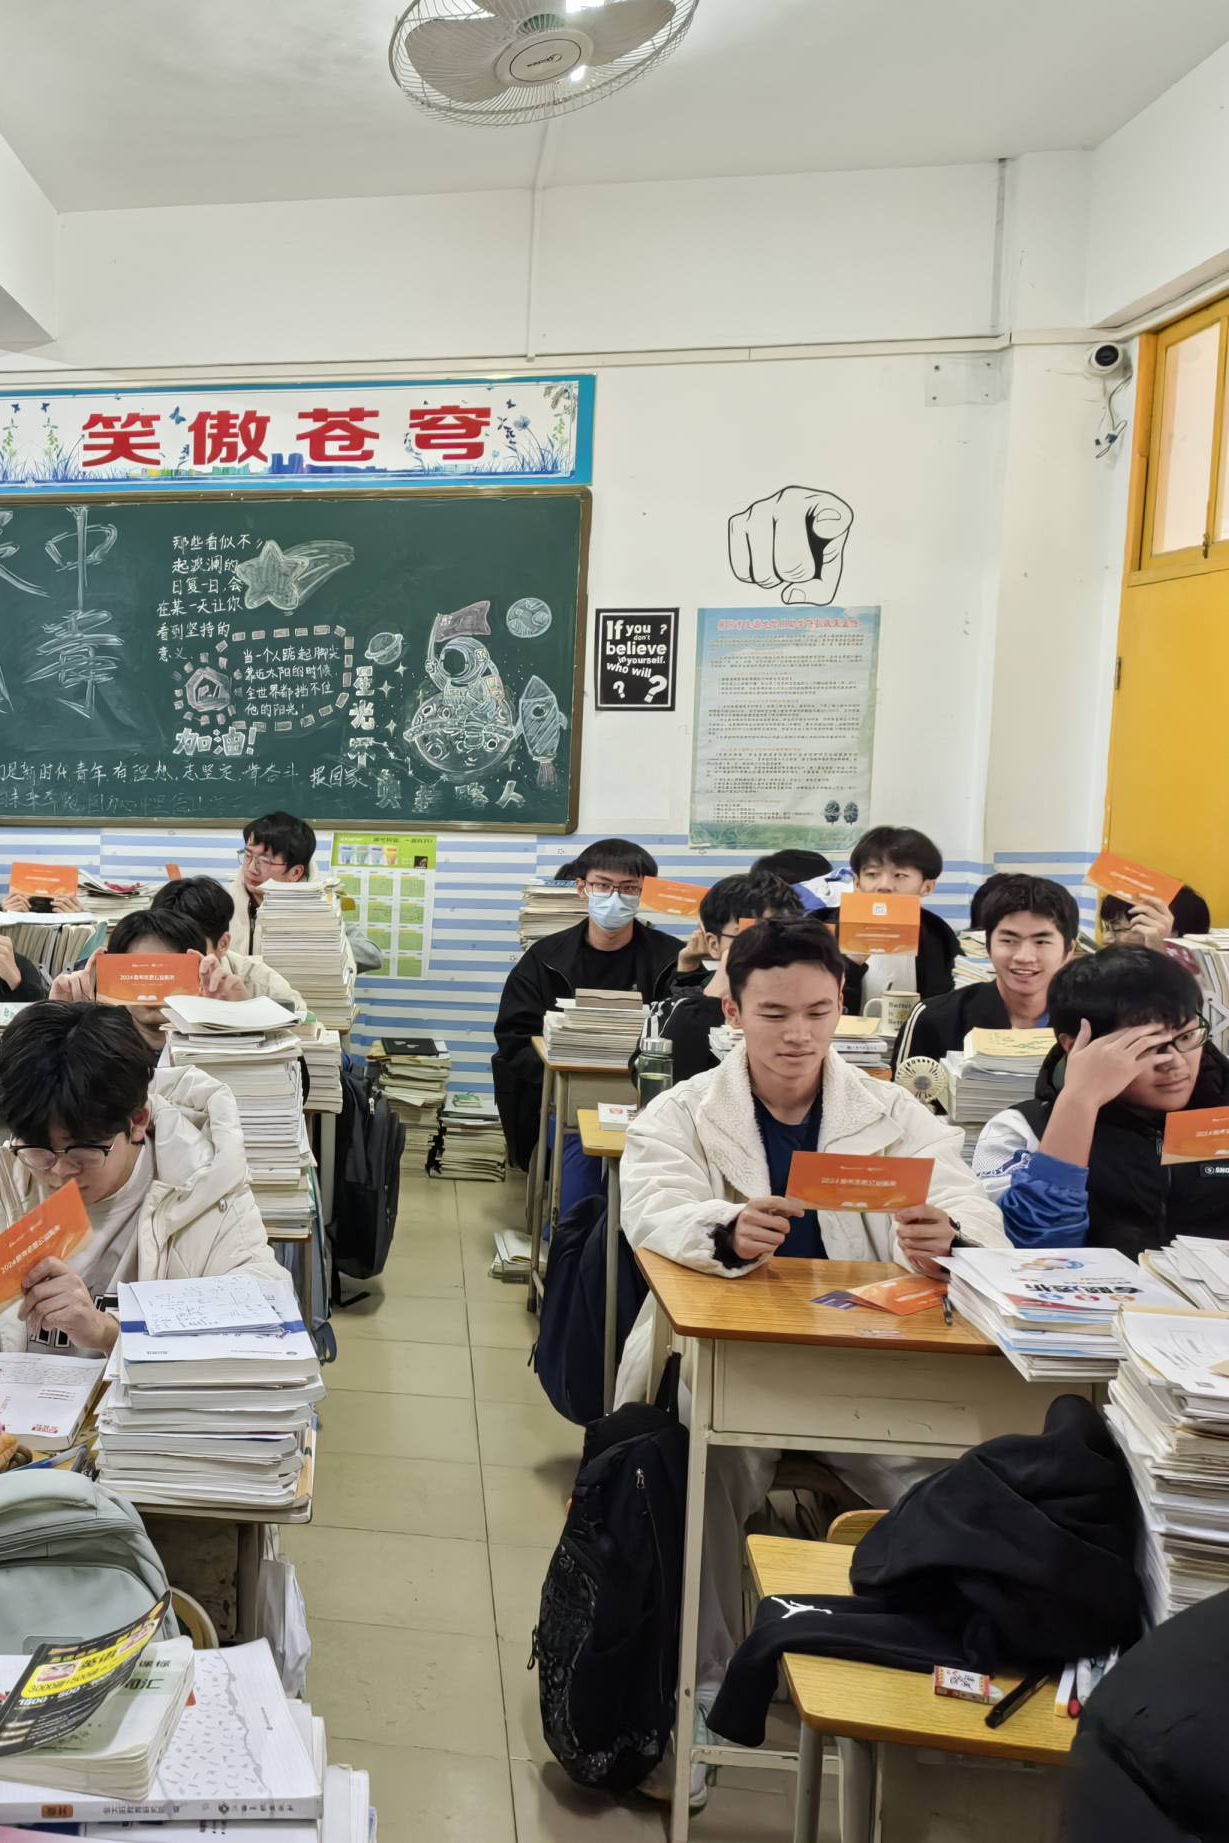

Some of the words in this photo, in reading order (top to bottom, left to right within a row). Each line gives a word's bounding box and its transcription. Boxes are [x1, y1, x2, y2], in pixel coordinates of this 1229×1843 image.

[82, 404, 492, 468] 笑傲苍穹
[172, 534, 251, 554] 那些看似不
[172, 556, 239, 575] 起波澜的
[156, 597, 244, 617] 在某一天让你
[156, 621, 231, 641] 看到坚持的
[606, 619, 624, 640] If
[625, 624, 651, 637] you
[660, 624, 668, 635] ?
[243, 646, 340, 665] 当一个人踮起脚尖
[606, 641, 667, 655] believe
[606, 662, 629, 674] who
[632, 667, 652, 678] will
[618, 655, 627, 664] in
[627, 655, 666, 666] yourself.
[245, 682, 335, 700] 全世界都挡不住
[613, 680, 626, 698] ?
[644, 674, 668, 703] ?
